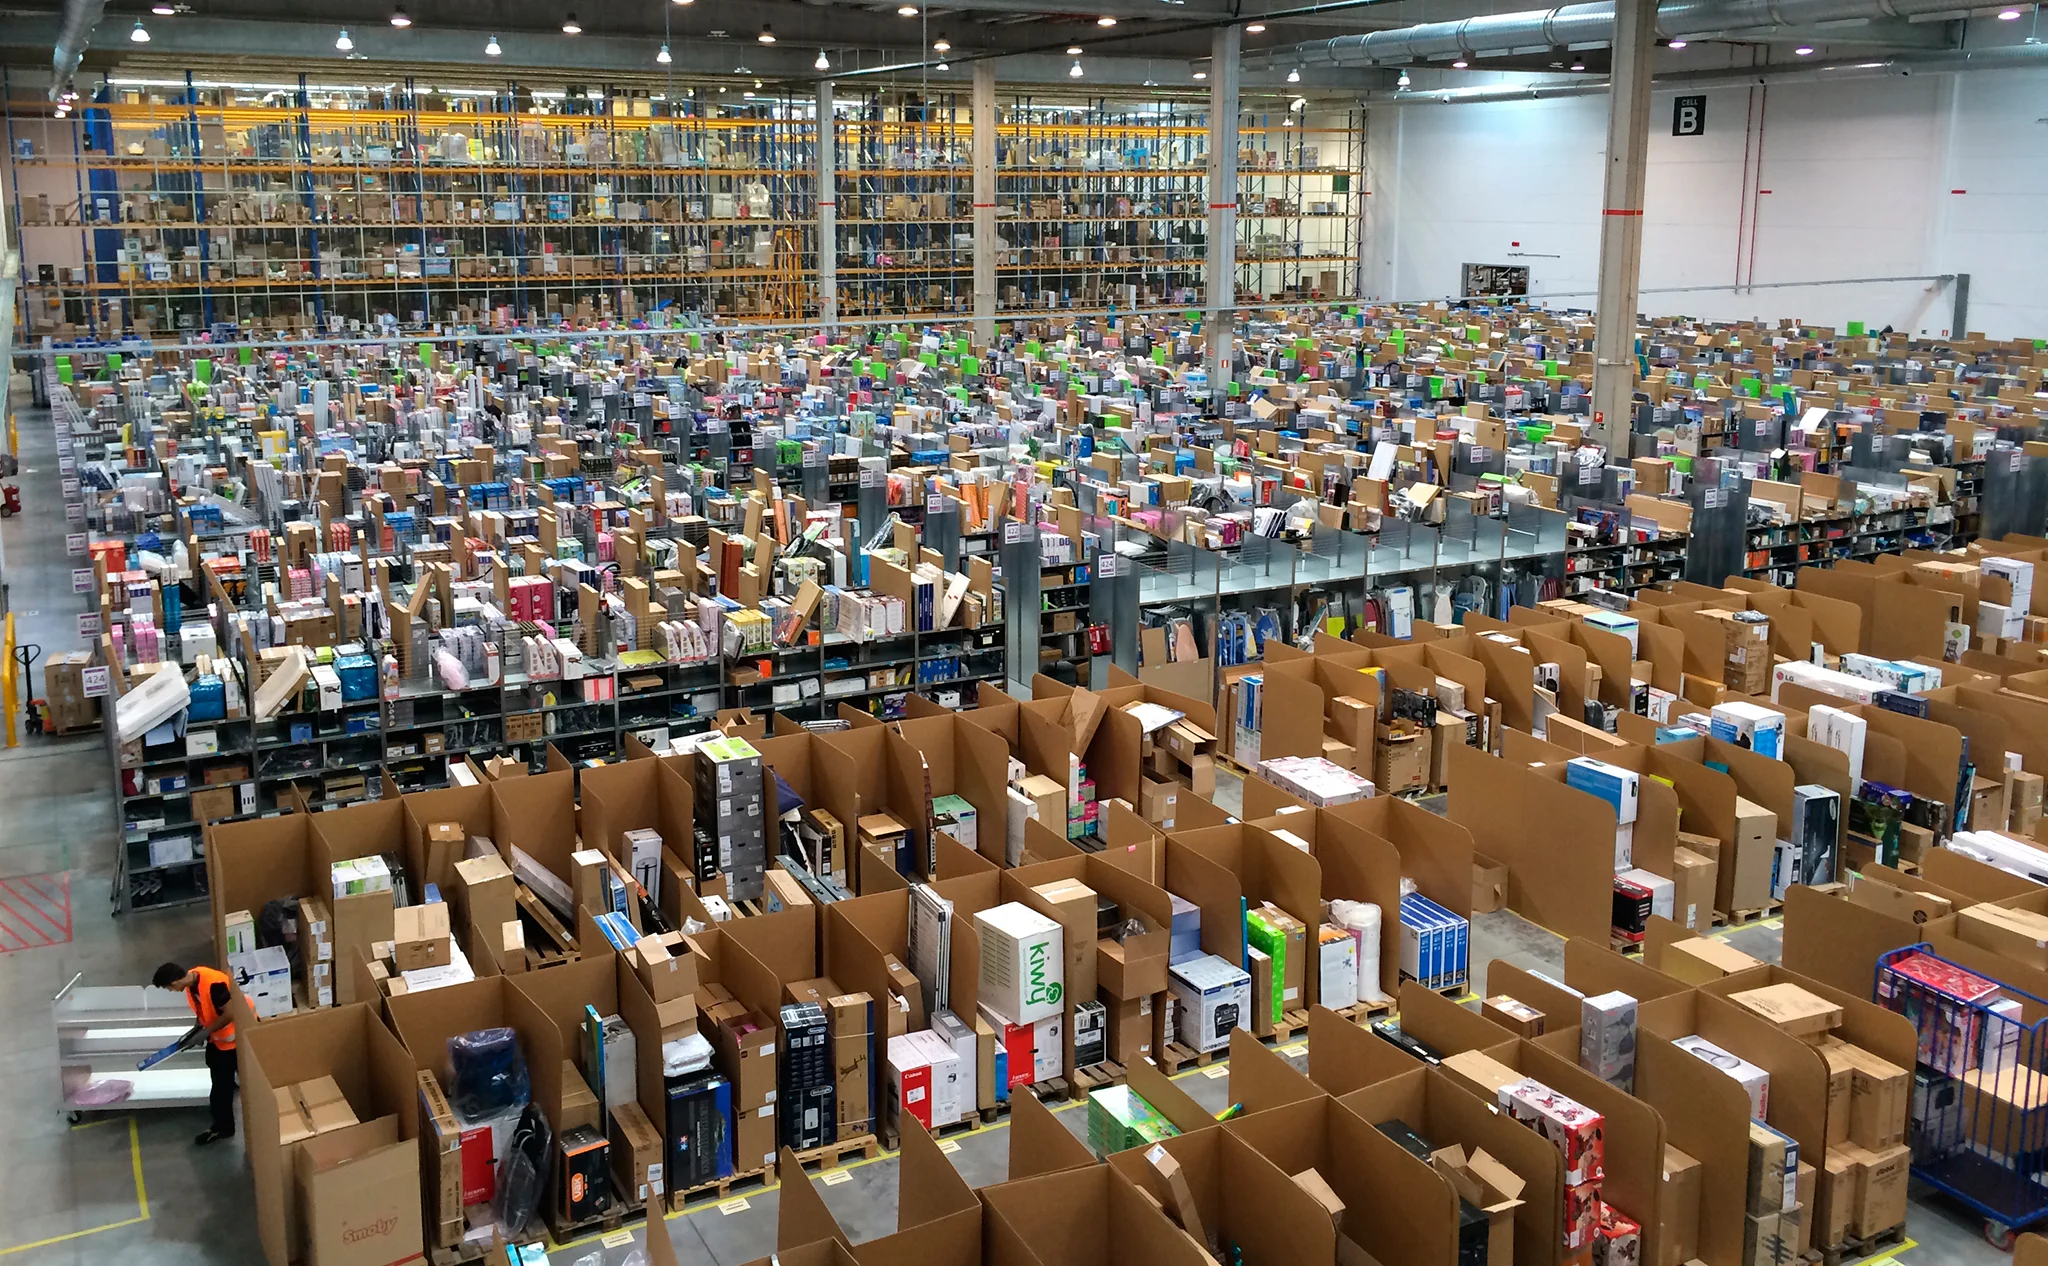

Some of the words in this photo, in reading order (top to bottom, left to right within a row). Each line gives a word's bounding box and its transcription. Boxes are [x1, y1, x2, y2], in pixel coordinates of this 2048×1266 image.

[1679, 106, 1698, 134] B
[1007, 527, 1019, 535] 422
[1101, 560, 1113, 568] 424
[75, 575, 91, 583] 420
[81, 620, 97, 629] 422
[86, 674, 105, 684] 424
[1785, 675, 1794, 683] LG
[1026, 941, 1050, 1006] kiwy
[904, 1071, 922, 1080] Canon
[573, 1177, 583, 1199] vax
[343, 1217, 398, 1245] Smoby
